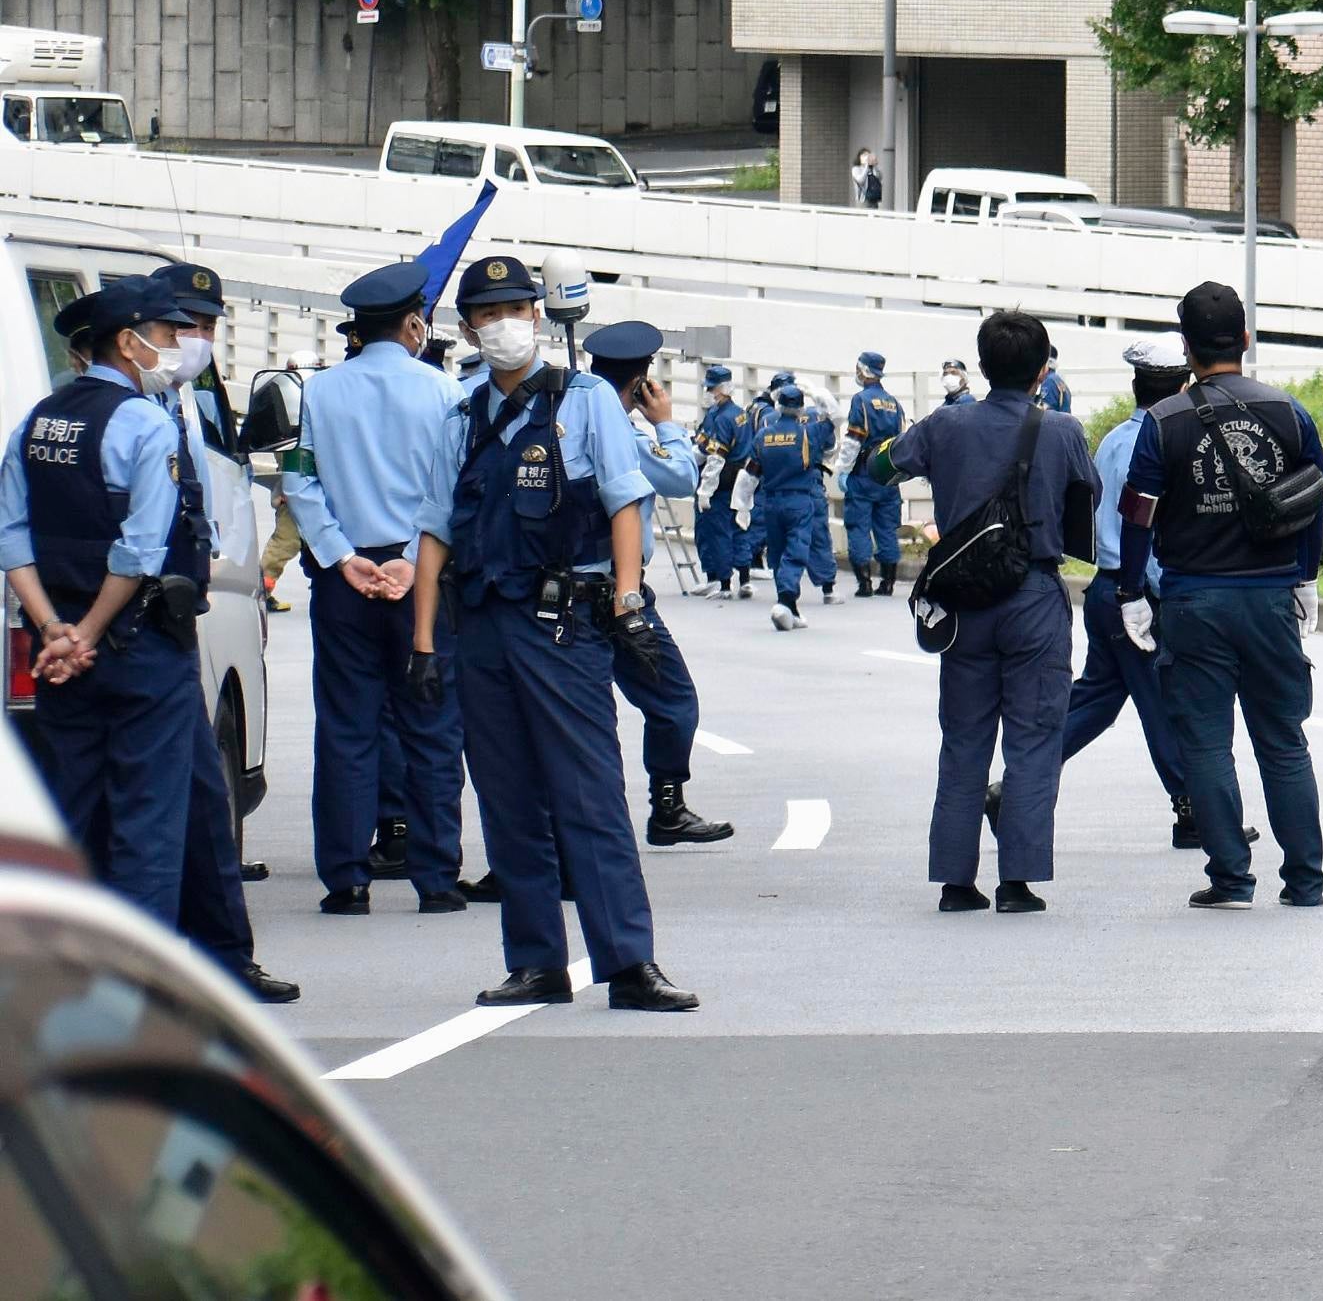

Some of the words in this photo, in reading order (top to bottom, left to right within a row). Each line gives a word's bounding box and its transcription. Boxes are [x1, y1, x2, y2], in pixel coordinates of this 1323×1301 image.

[31, 416, 87, 443] 警視庁
[28, 444, 79, 465] POLICE
[517, 478, 548, 488] POLICE
